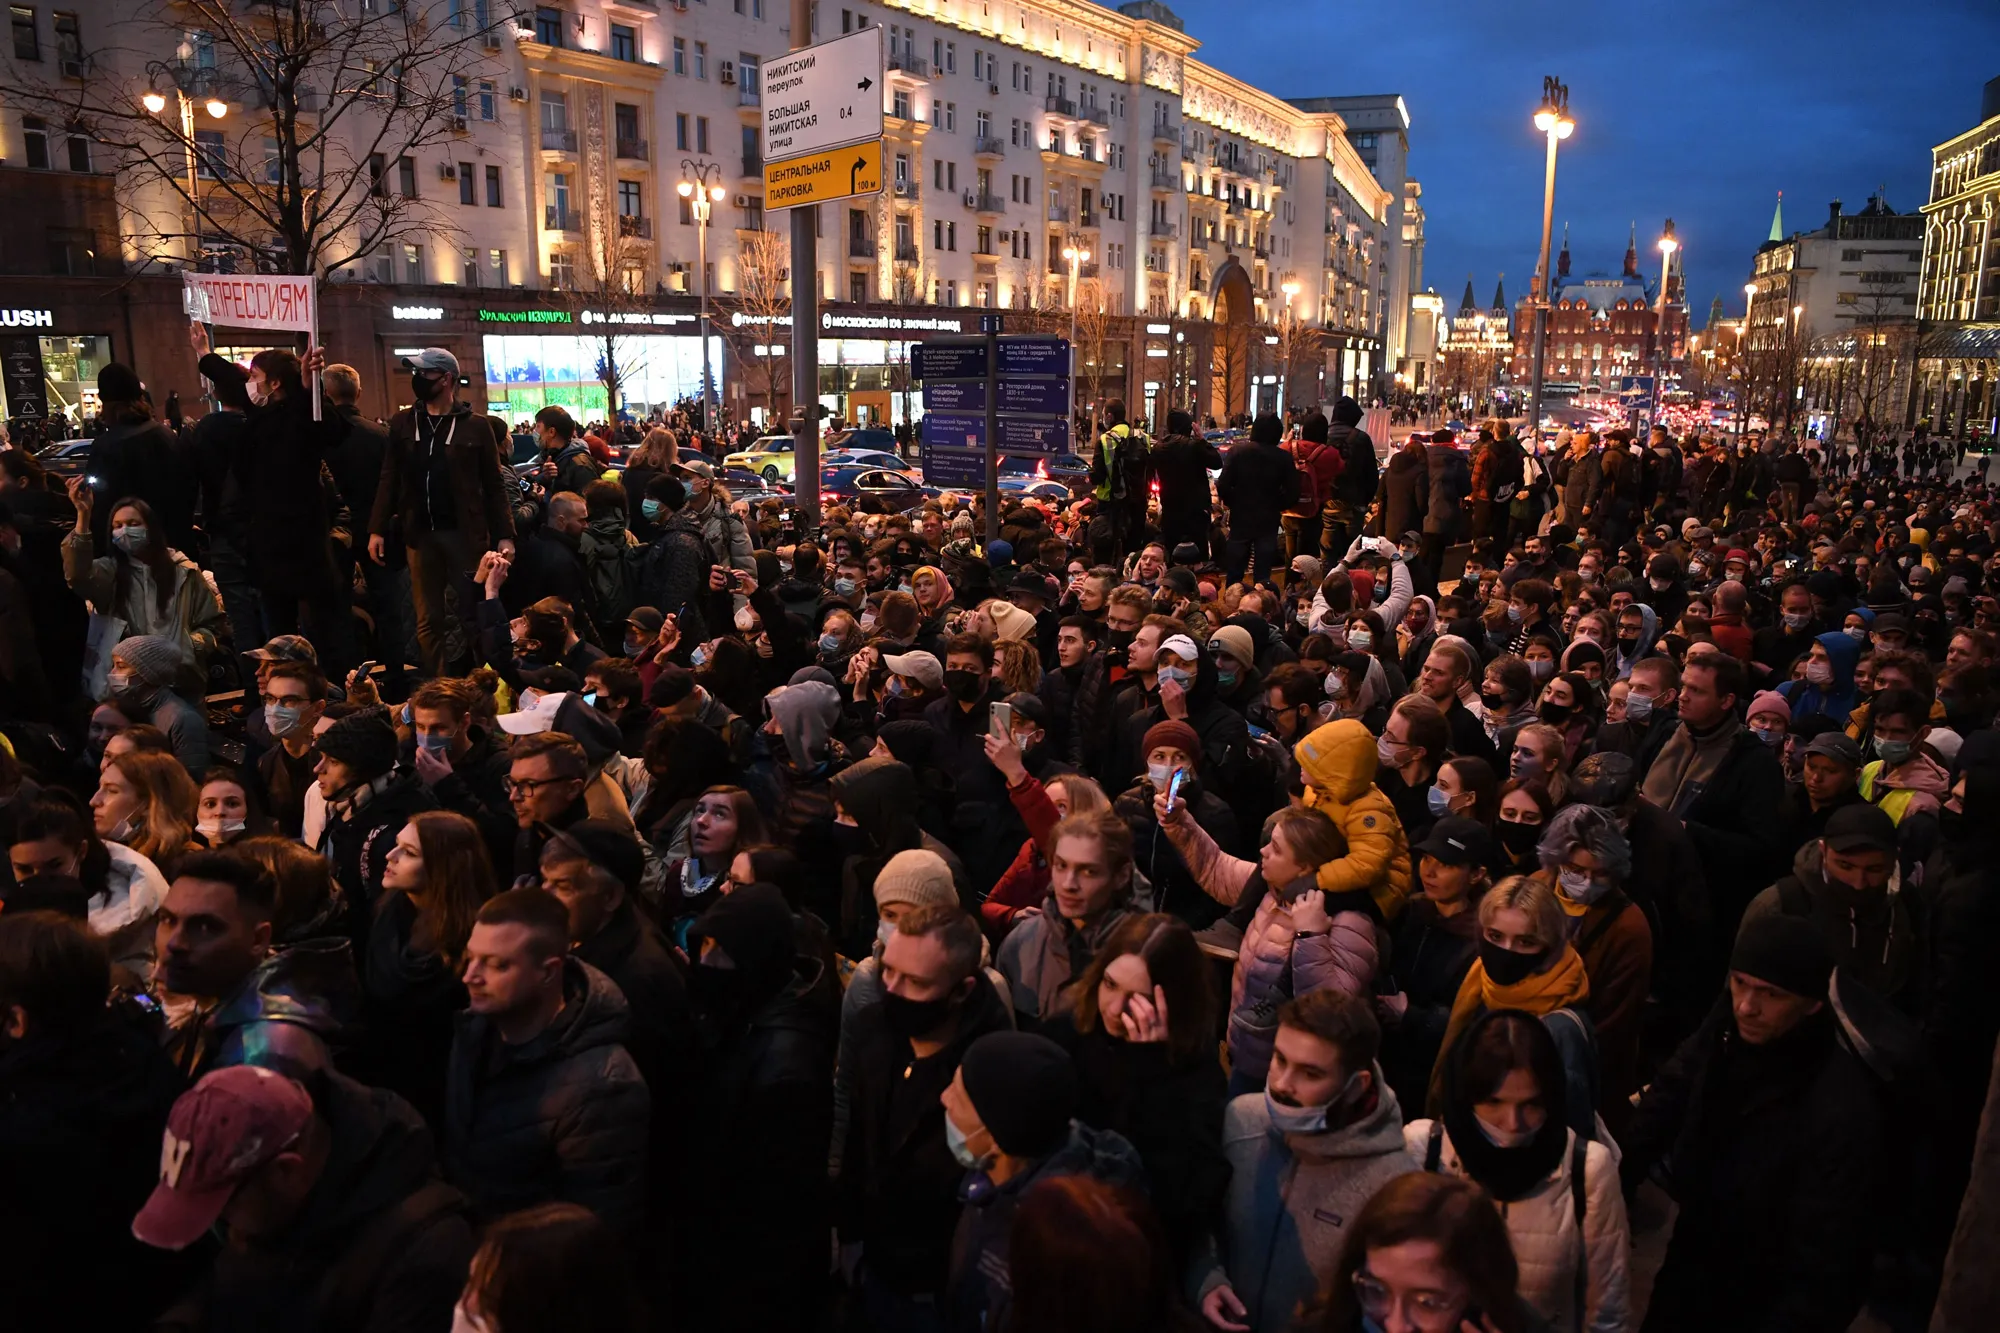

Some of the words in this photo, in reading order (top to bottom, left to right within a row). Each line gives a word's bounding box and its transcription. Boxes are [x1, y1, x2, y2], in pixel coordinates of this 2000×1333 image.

[767, 53, 816, 81] НИКИТСКИЙ
[767, 75, 804, 95] переулок
[768, 99, 810, 122] БОЛЬШАЯ
[839, 105, 853, 120] 0.4
[769, 114, 818, 137] НИКИТСКАЯ
[769, 135, 793, 153] улица
[769, 160, 831, 184] ЦЕНТРАЛЬНАЯ
[770, 182, 814, 201] ПАРКОВКА
[857, 180, 869, 191] 100
[199, 281, 309, 323] ЕПРЕССИЯМ
[0, 309, 54, 327] USH
[528, 310, 573, 324] ИЗУМРУД
[832, 316, 889, 328] МОСКОВСКИЙ
[937, 320, 961, 333] ЗАВОД
